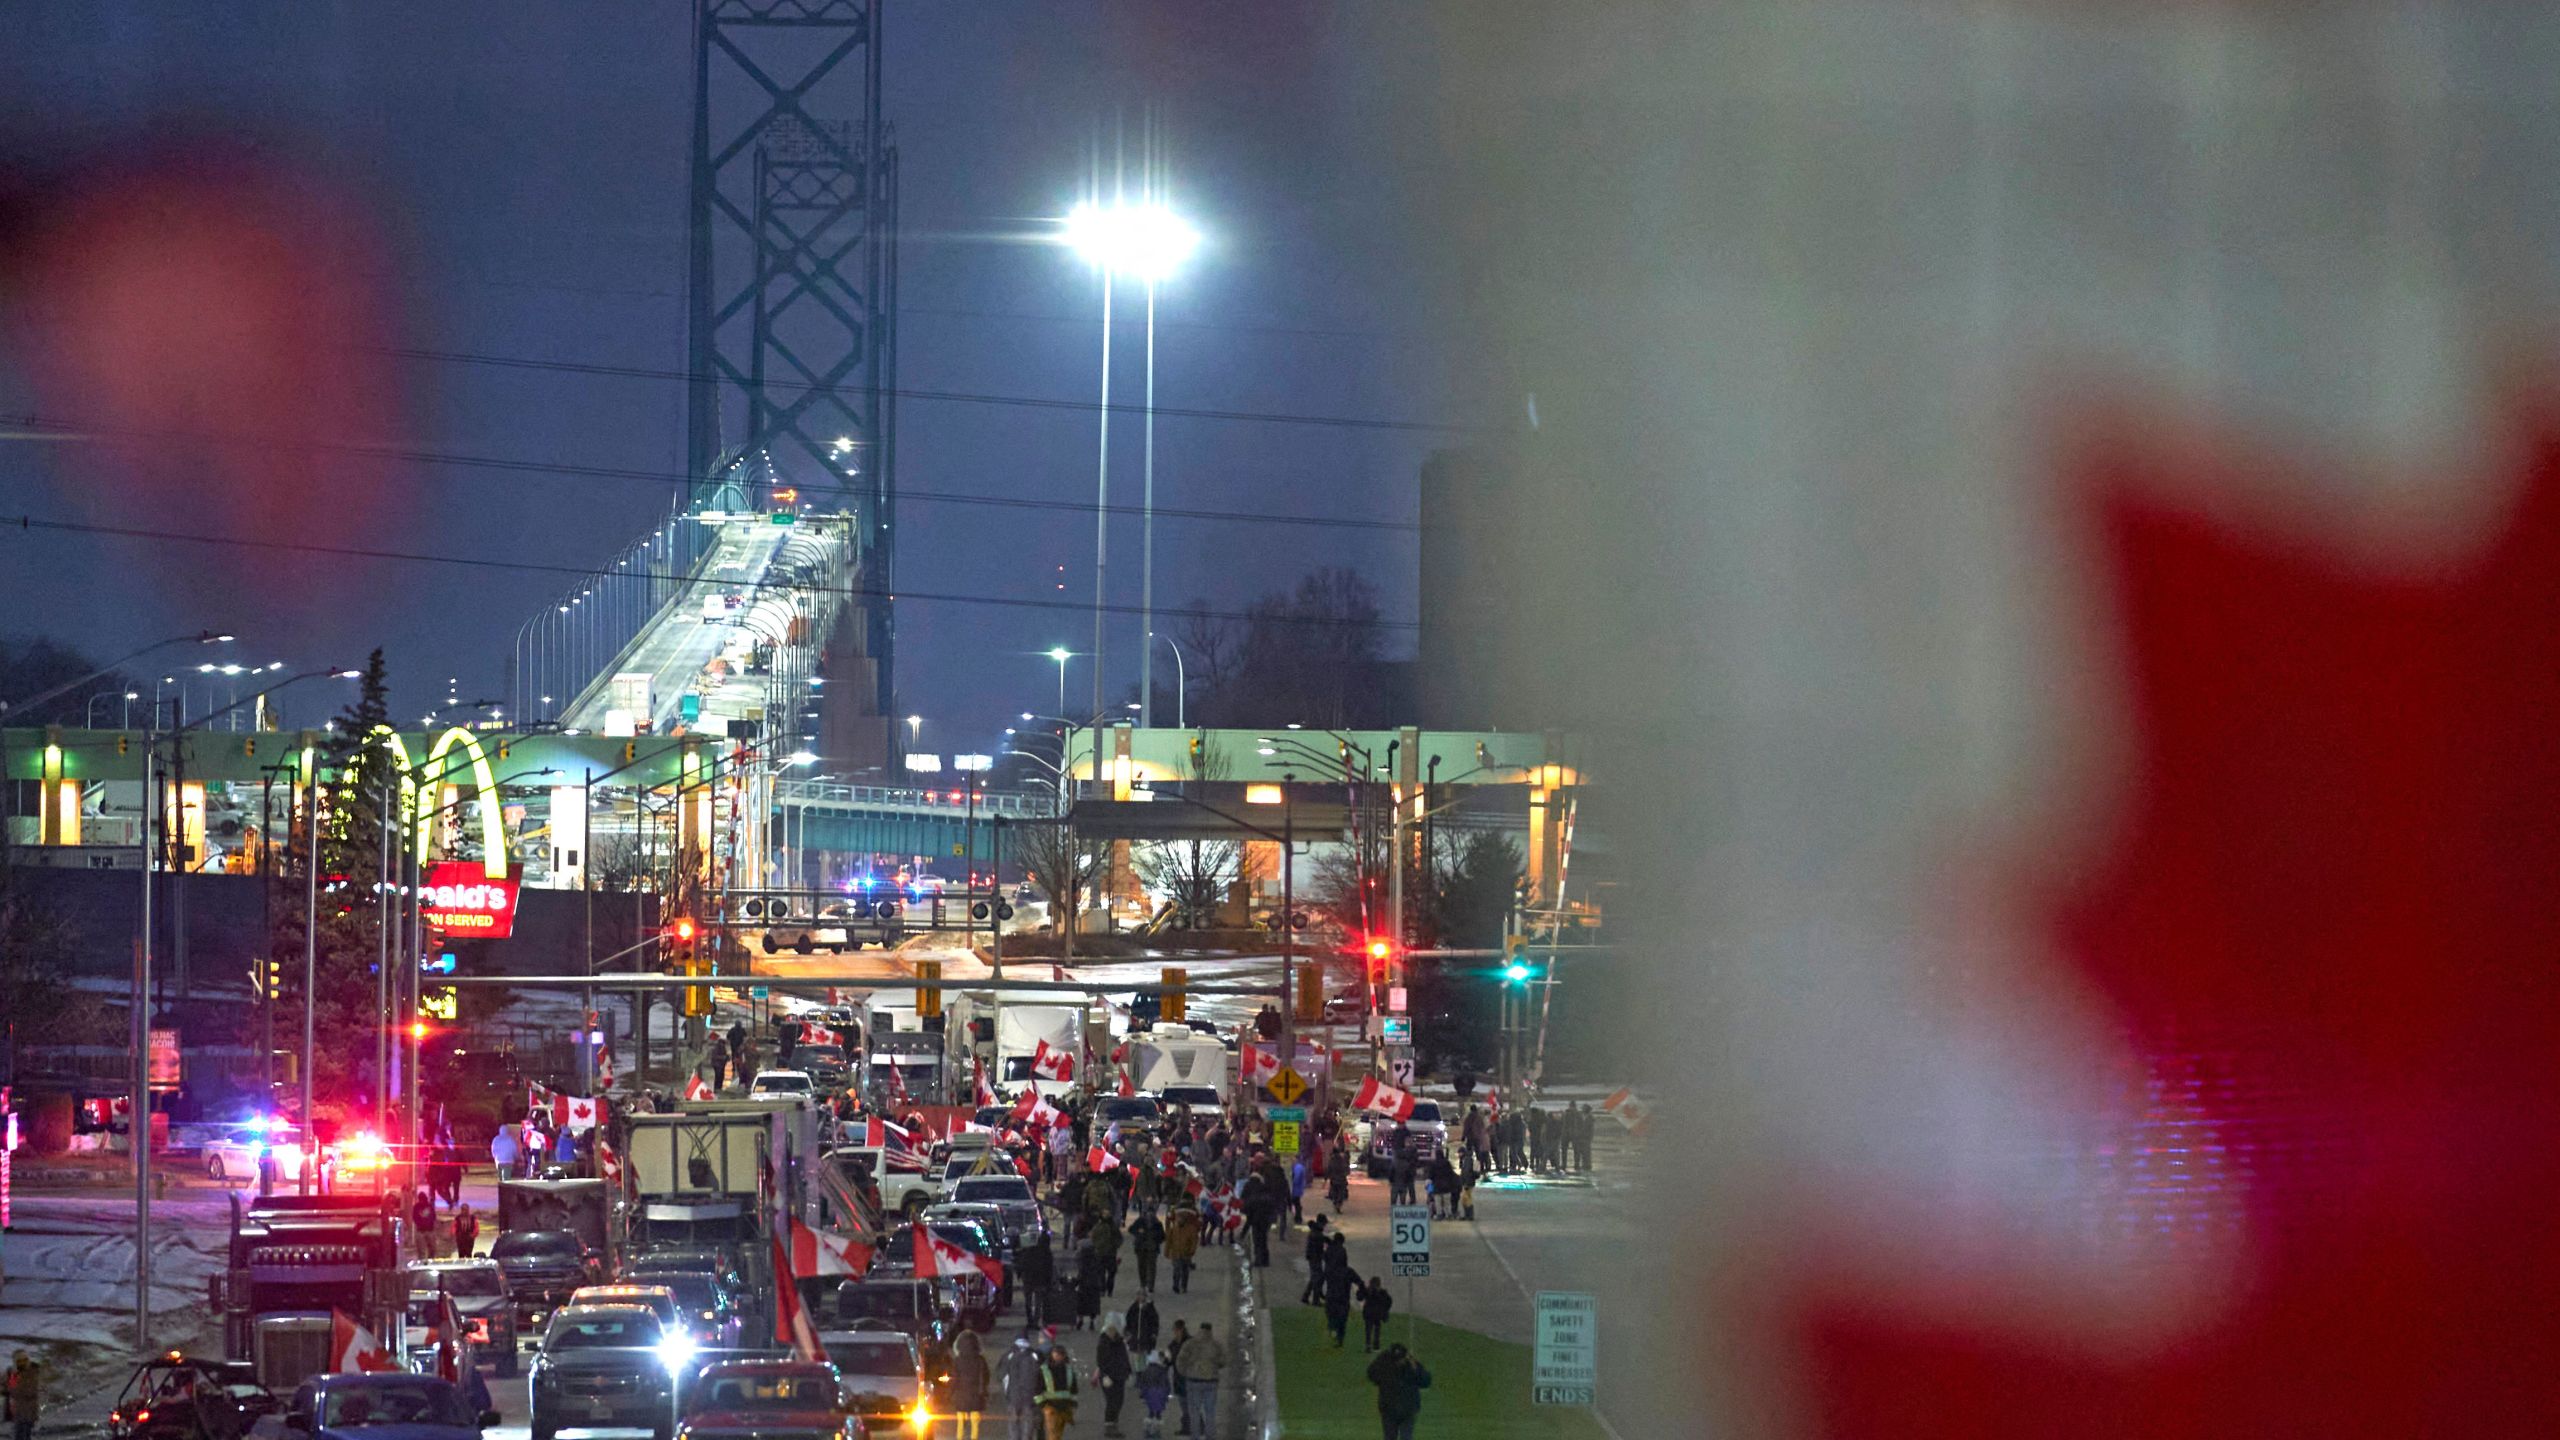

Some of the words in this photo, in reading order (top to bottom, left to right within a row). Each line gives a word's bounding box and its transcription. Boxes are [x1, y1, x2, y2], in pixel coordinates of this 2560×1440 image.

[445, 914, 494, 927] SERVED
[1394, 1211, 1428, 1219] MAXIMUM
[1396, 1223, 1425, 1244] 50
[1396, 1253, 1425, 1262] km/h
[1393, 1265, 1430, 1276] BEGINS
[1540, 1298, 1594, 1311] COMMUNITY
[1549, 1314, 1583, 1328] SAFETY
[1553, 1331, 1579, 1344] ZONE
[1552, 1351, 1578, 1362] FINES
[1537, 1367, 1593, 1378] INCREASED
[1540, 1387, 1590, 1404] ENDS
